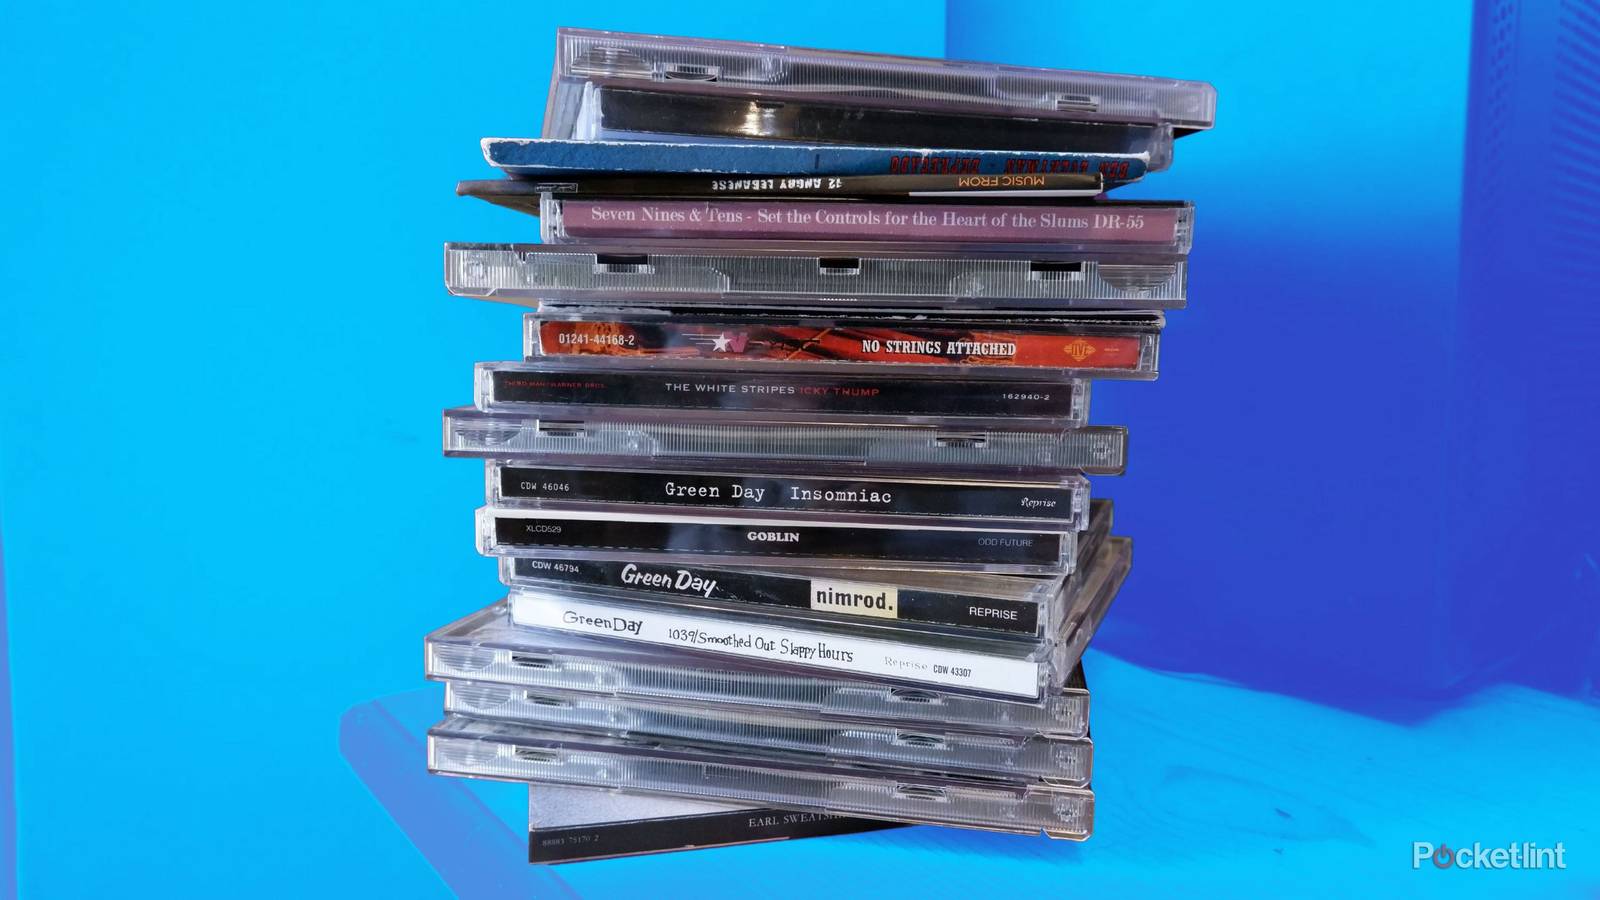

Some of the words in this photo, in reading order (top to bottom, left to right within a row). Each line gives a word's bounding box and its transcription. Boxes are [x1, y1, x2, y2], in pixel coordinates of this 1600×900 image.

[712, 179, 774, 190] LEBANESE
[779, 178, 822, 190] ANGRY
[828, 178, 843, 189] 12
[958, 176, 999, 187] FROM
[1002, 176, 1045, 186] MUSIC
[591, 207, 635, 221] Seven
[641, 207, 685, 222] Nines
[689, 208, 701, 222] &
[705, 208, 743, 223] Tens
[757, 209, 782, 223] Set
[786, 210, 811, 225] the
[815, 210, 881, 225] Controls
[885, 211, 908, 225] for
[911, 211, 937, 225] the
[941, 211, 987, 227] Heart
[991, 212, 1008, 227] of
[1012, 213, 1037, 228] the
[1040, 213, 1089, 229] Slums
[1094, 214, 1145, 229] DR-55
[558, 333, 635, 346] 01241-44168-2
[862, 339, 880, 353] NO
[886, 340, 941, 355] STRINGS
[946, 341, 1017, 356] ATTACHED
[665, 383, 691, 392] THE
[695, 384, 737, 393] WHITE
[741, 385, 795, 395] STRIPES
[799, 387, 828, 396] ICKY
[834, 387, 880, 397] THUMP
[1002, 393, 1050, 401] 162940-2
[520, 481, 537, 491] CDW
[542, 482, 570, 492] 46046
[665, 482, 720, 498] Green
[731, 484, 766, 503] Day
[790, 486, 892, 503] Insomniac
[1021, 497, 1057, 508] Reprise
[526, 525, 561, 533] XLCD529
[747, 531, 800, 543] GOBLIN
[978, 538, 998, 546] ODD
[1000, 538, 1033, 547] FUTURE
[532, 560, 551, 570] CDW
[553, 563, 580, 574] 46794
[621, 564, 672, 589] Green
[674, 569, 717, 599] Day
[816, 587, 894, 611] nimrod.
[968, 606, 1018, 621] REPRISE
[754, 638, 776, 652] Out
[780, 639, 816, 660] Slappy
[818, 643, 853, 662] Hours
[884, 656, 929, 670] Reprise
[933, 664, 949, 675] CDW
[950, 667, 972, 678] 43307
[749, 816, 781, 828] EARL
[593, 834, 601, 842] 2
